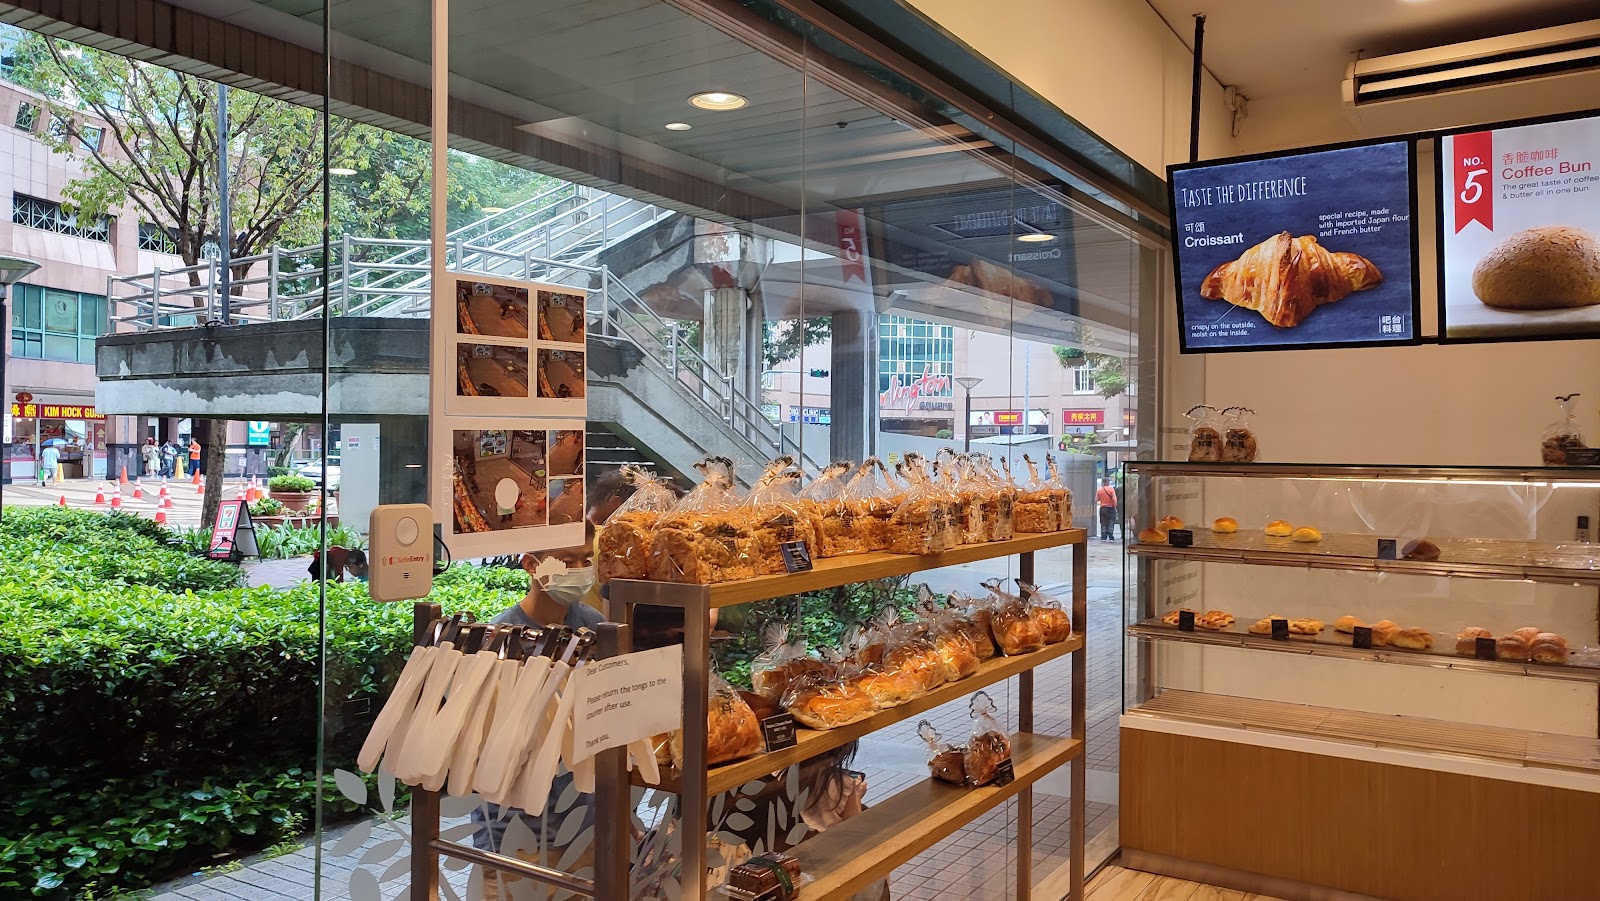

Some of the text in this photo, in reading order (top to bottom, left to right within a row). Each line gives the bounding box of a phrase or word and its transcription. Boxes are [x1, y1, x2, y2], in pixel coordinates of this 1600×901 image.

[1463, 157, 1484, 167] NO.
[1502, 148, 1558, 165] 香脆咖啡
[1502, 161, 1591, 180] Coffee Bun
[1182, 176, 1308, 208] TASTE THE DIFFERENCE
[1460, 168, 1488, 204] 5
[1518, 182, 1538, 190] great
[1510, 191, 1533, 199] butter
[1319, 207, 1390, 222] special recipe, made
[1319, 214, 1409, 229] with imported Japan flour
[1319, 229, 1332, 237] and
[1334, 226, 1358, 235] French
[1185, 232, 1244, 248] Croissant
[880, 364, 951, 416] rlington
[44, 406, 59, 417] KIM
[62, 407, 82, 418] HOCK
[397, 556, 424, 564] SafeEntry
[586, 660, 630, 676] Dear Customers,
[586, 694, 601, 705] Please
[602, 690, 618, 699] return
[620, 686, 630, 694] the
[632, 682, 648, 691] tongs
[586, 700, 632, 720] counter after use.
[585, 738, 599, 748] Thank
